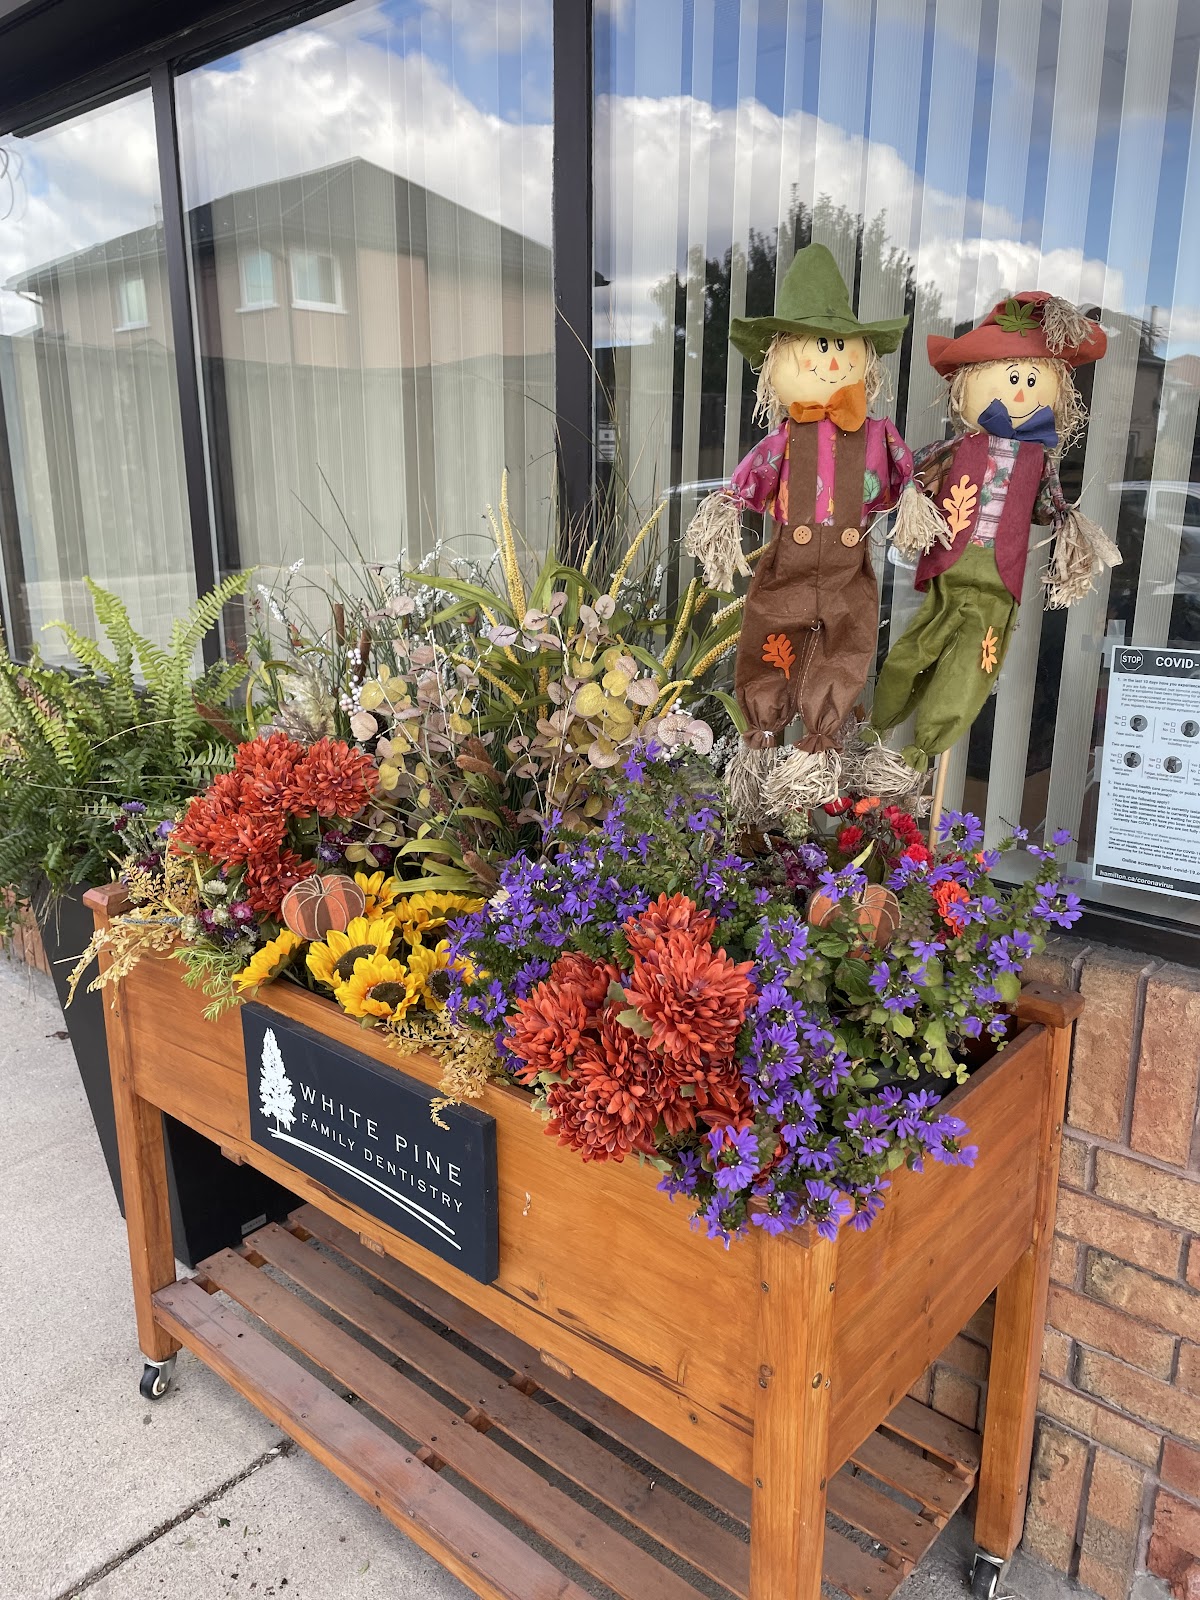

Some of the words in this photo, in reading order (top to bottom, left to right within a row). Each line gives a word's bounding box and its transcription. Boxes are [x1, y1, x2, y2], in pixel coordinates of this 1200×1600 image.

[1122, 655, 1141, 664] STOP
[1155, 656, 1199, 669] COVID-
[1099, 870, 1174, 889] hamilton.ca/coronavirus
[300, 1082, 379, 1140] WHITE
[395, 1133, 462, 1186] PINE
[301, 1112, 356, 1151] FAMILY
[364, 1147, 463, 1213] DENTISTRY
